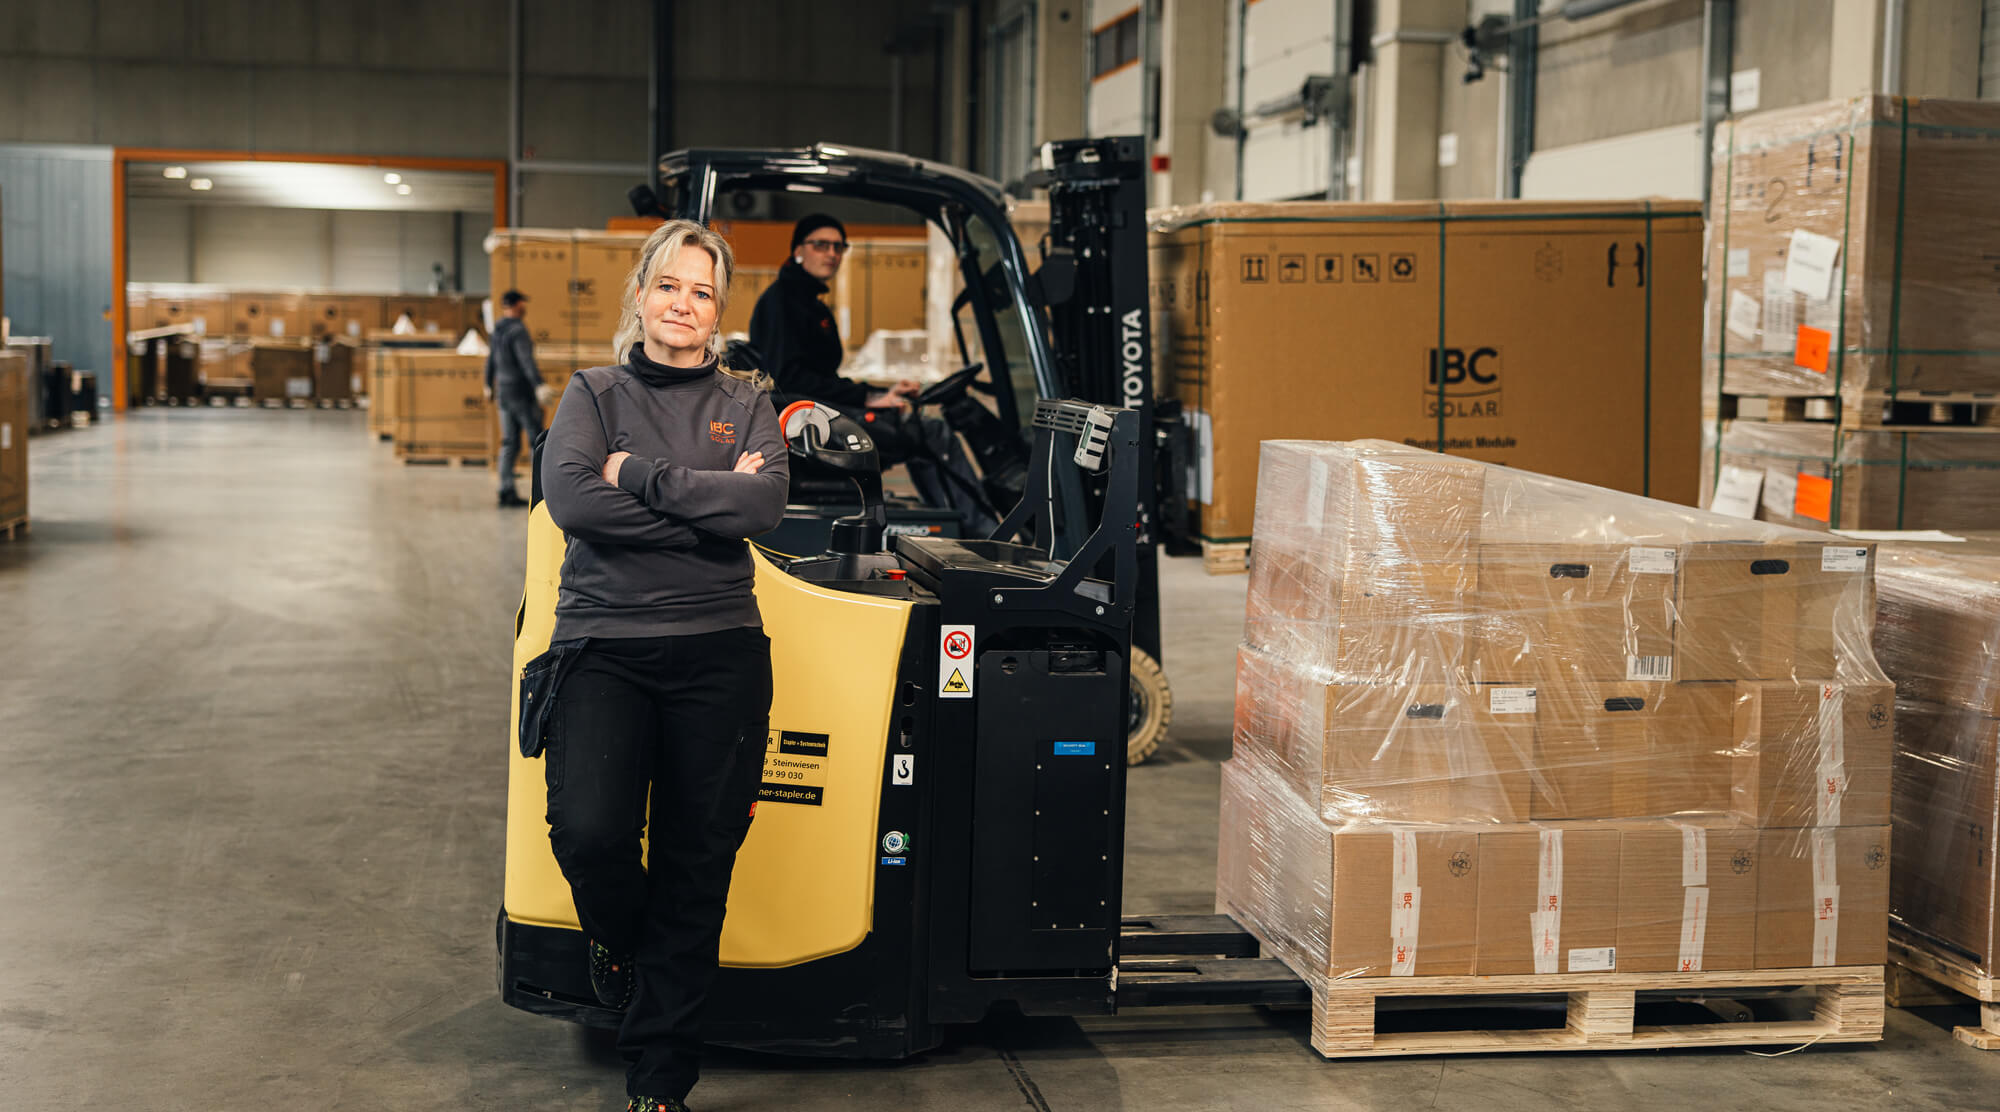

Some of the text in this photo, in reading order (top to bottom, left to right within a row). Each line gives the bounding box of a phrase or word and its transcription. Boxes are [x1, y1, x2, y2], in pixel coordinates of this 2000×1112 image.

[1122, 308, 1144, 409] TOYOTA
[1429, 347, 1498, 385] IBC
[1428, 401, 1498, 418] SOLAR
[710, 420, 735, 434] IBC
[773, 758, 820, 770] Steinwiesen
[775, 770, 786, 778] 99
[788, 771, 804, 780] 030
[758, 788, 817, 800] ner-stapler.de
